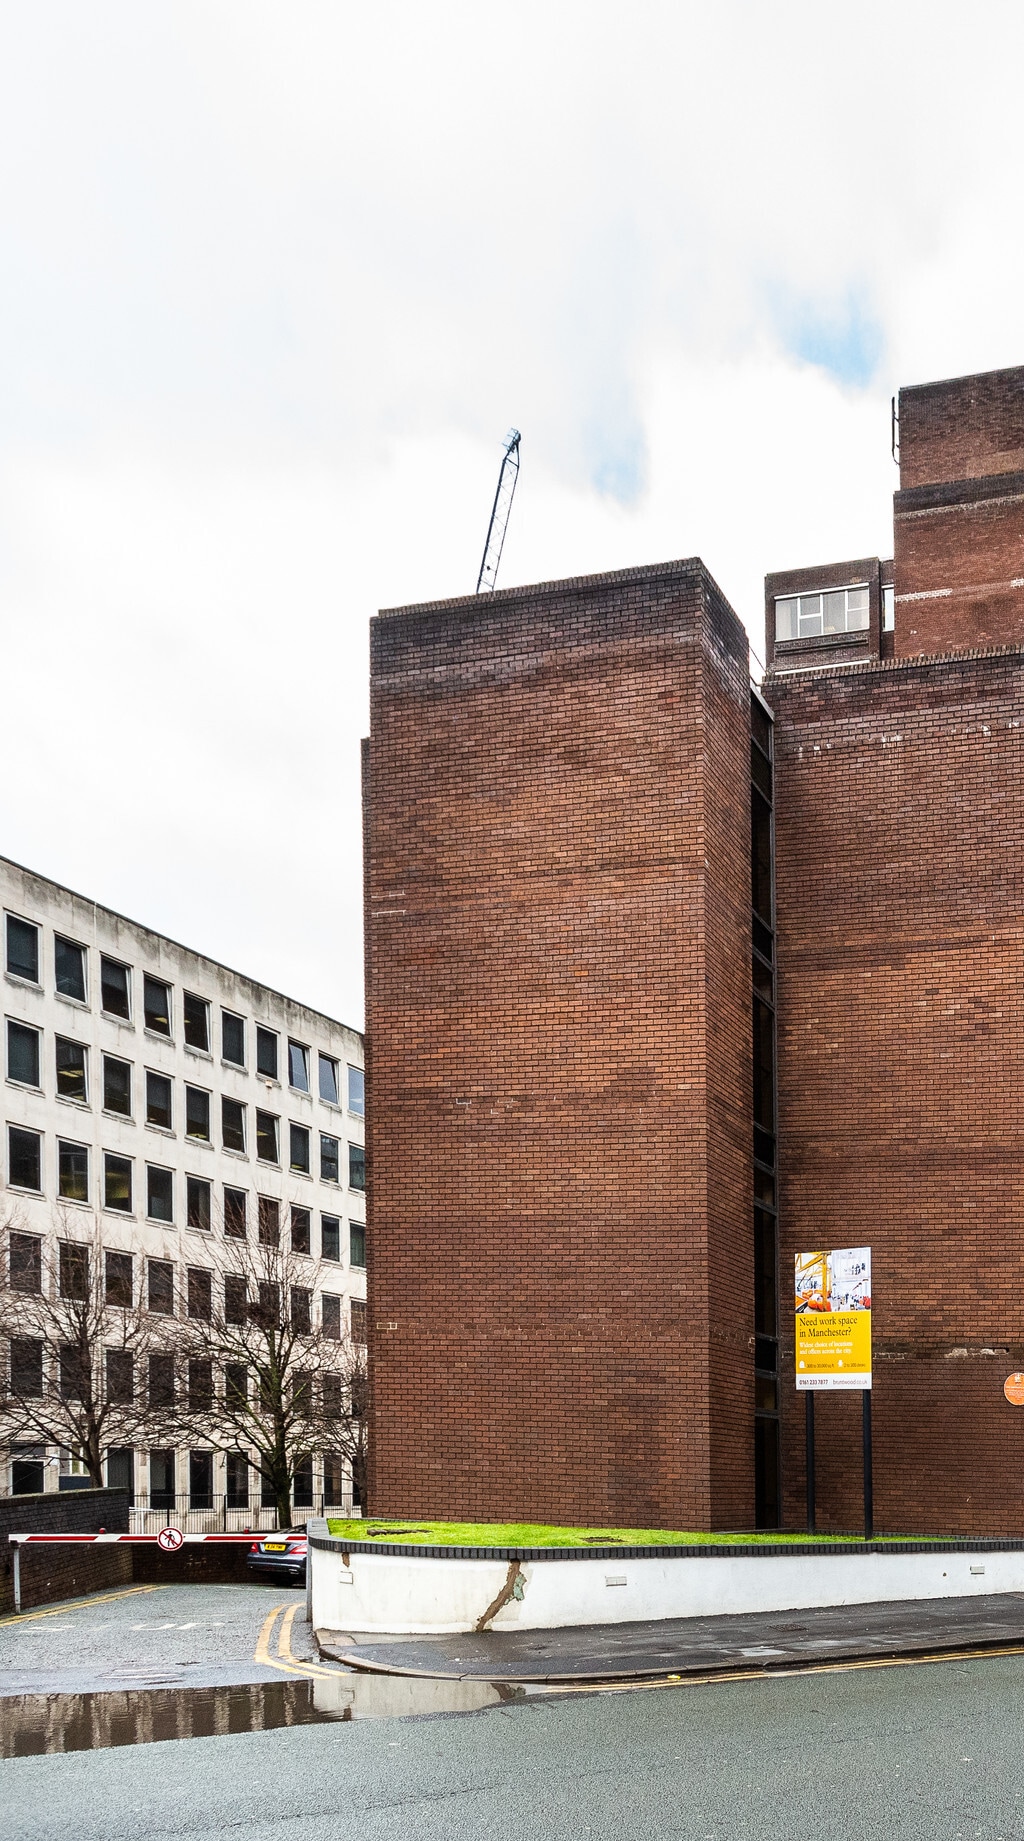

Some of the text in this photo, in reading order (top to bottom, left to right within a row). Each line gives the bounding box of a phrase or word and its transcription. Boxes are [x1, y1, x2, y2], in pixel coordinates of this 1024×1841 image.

[799, 1316, 858, 1326] Need work space
[799, 1327, 851, 1337] in Manchester?
